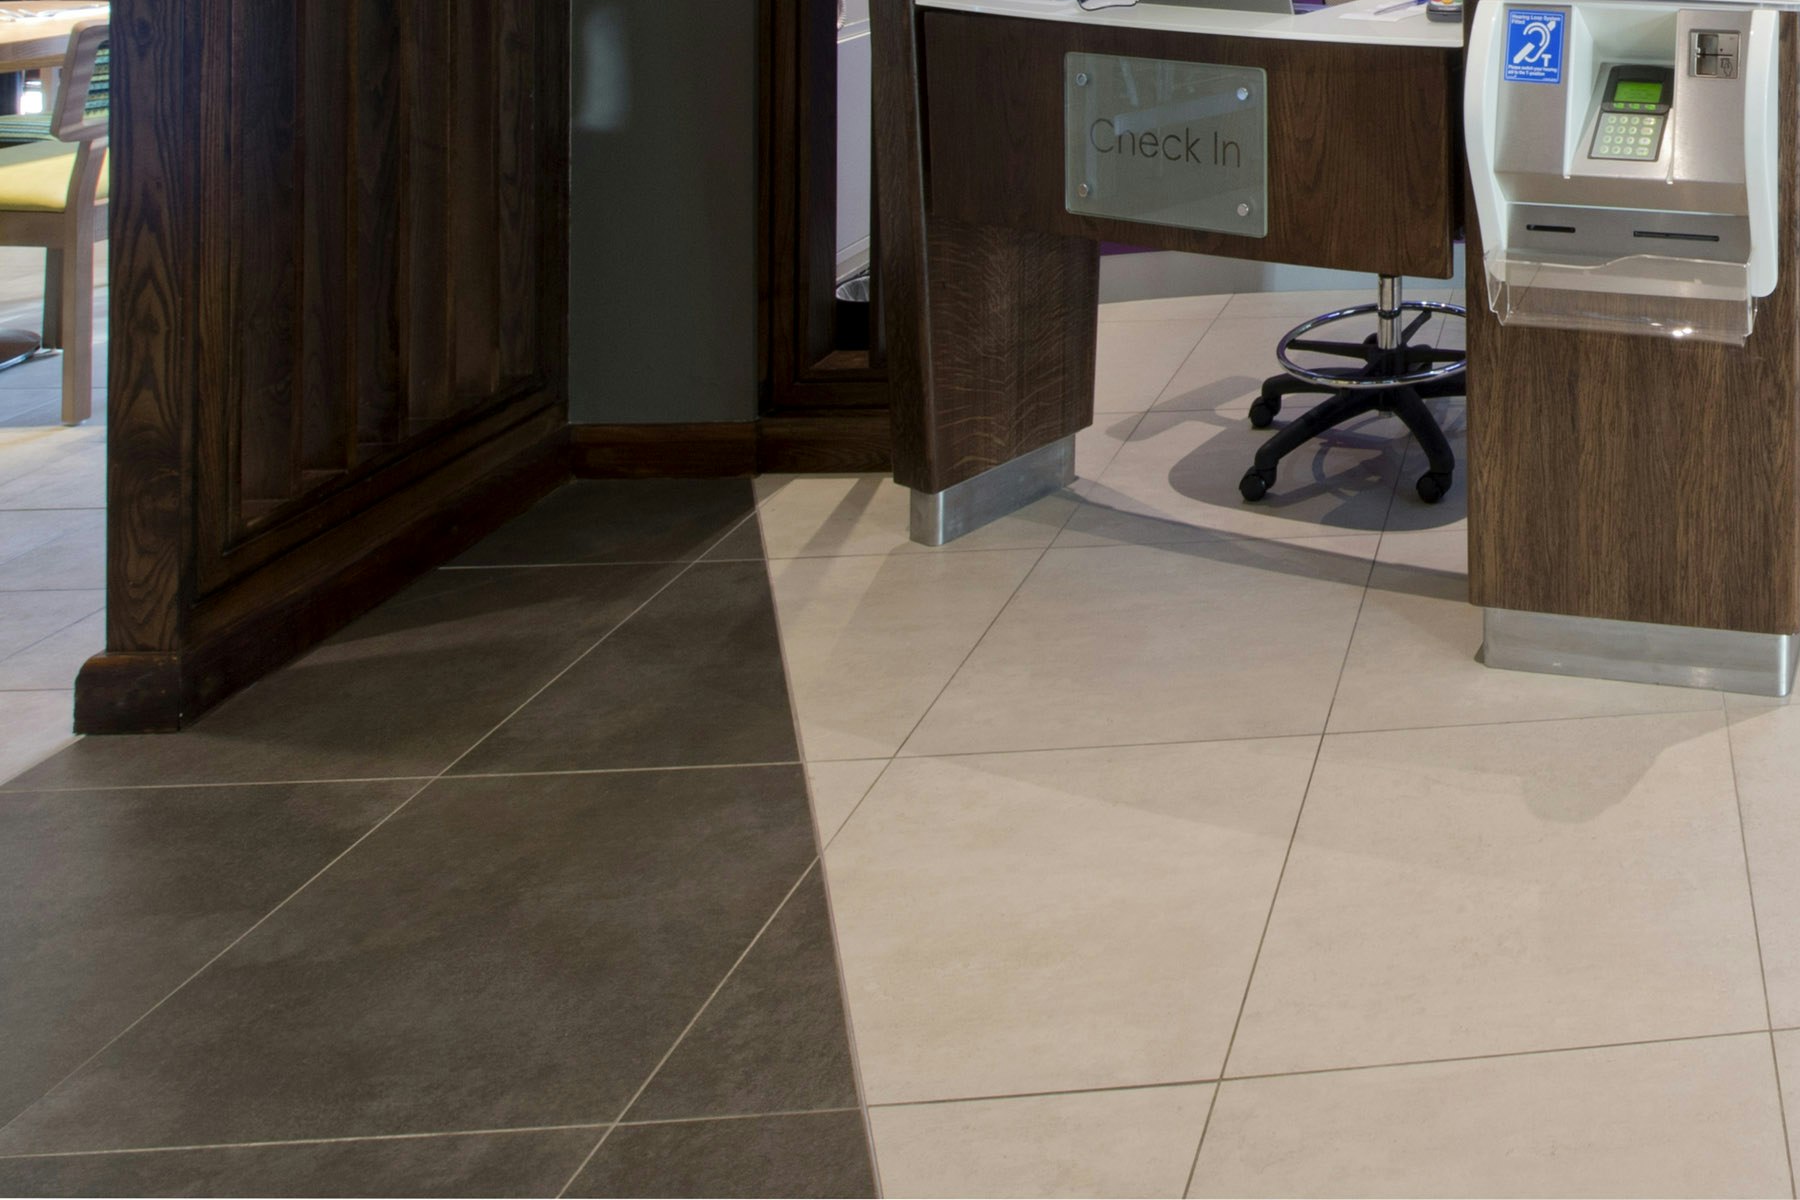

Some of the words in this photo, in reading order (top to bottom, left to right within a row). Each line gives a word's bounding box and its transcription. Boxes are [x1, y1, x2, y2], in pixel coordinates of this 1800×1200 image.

[1541, 54, 1552, 67] T
[1090, 117, 1201, 164] Check
[1214, 131, 1241, 168] In
